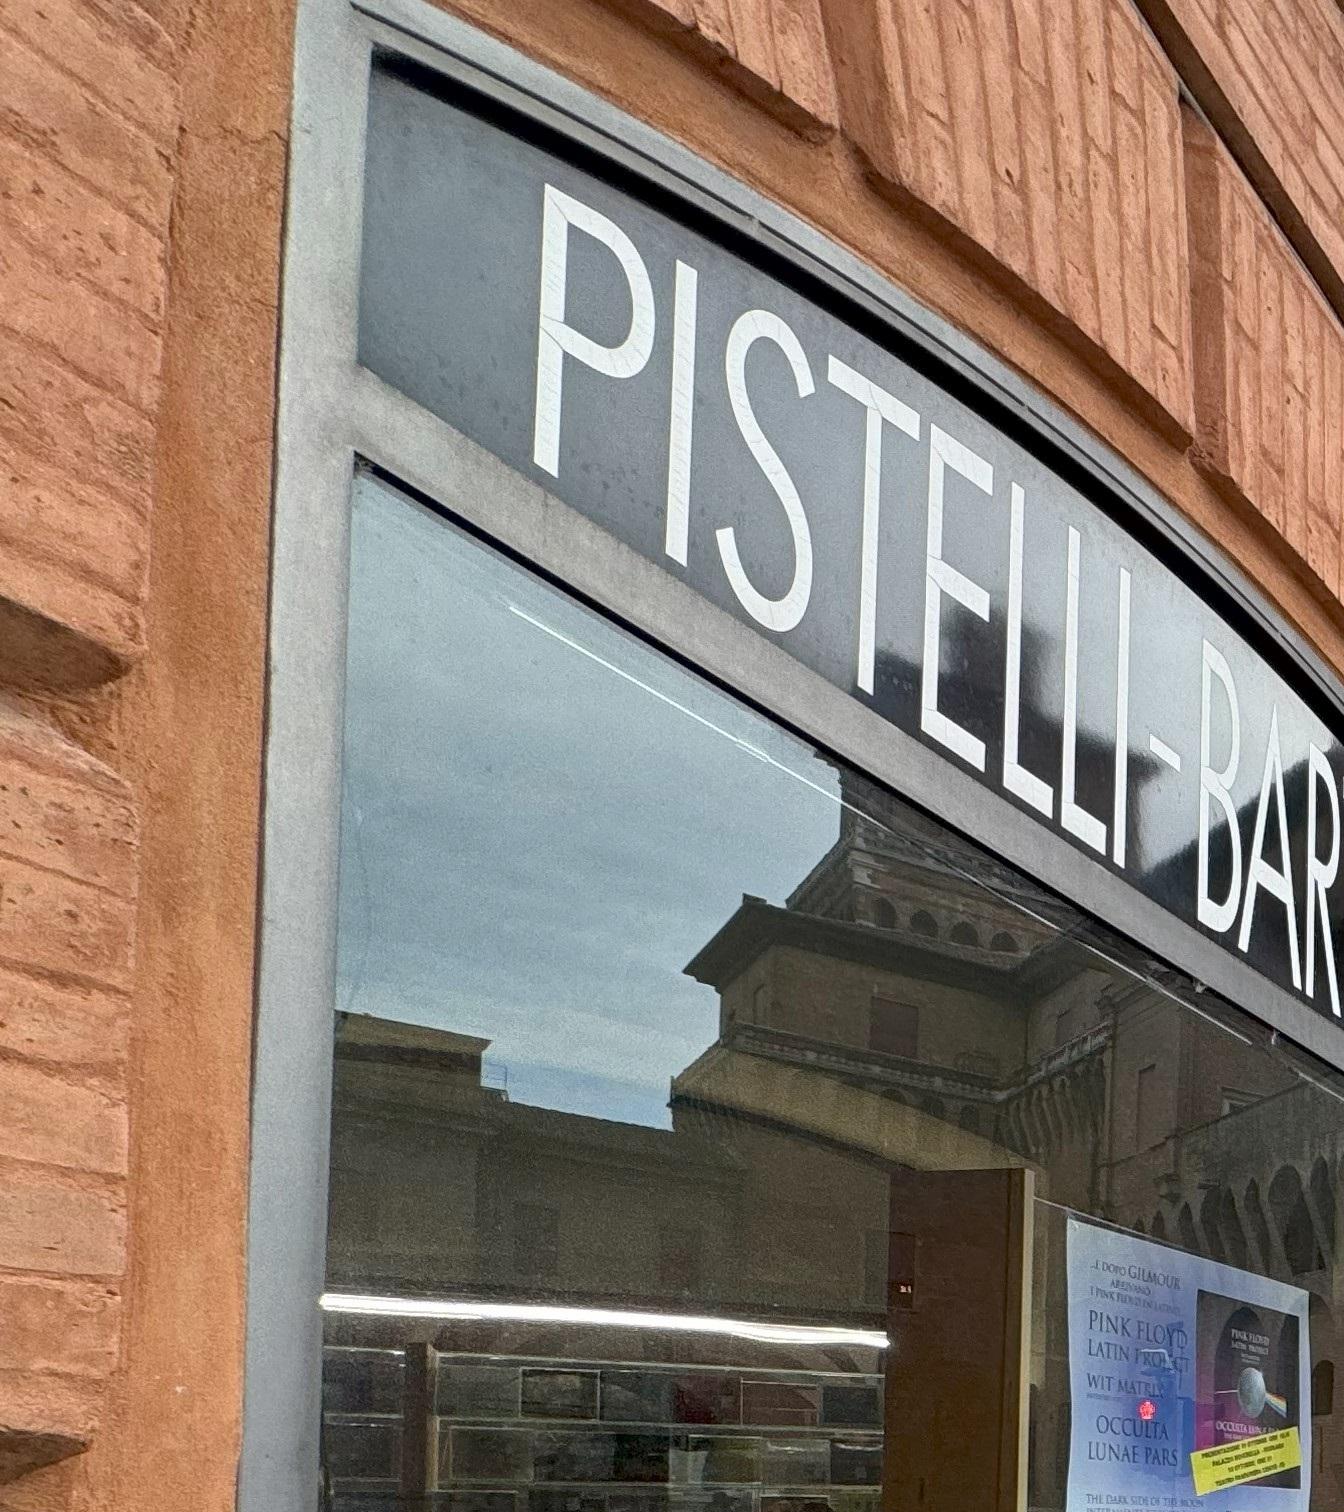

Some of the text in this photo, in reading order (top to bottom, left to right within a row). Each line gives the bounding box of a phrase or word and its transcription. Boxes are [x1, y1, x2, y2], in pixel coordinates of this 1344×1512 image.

[1089, 1310, 1188, 1350] PINK FLOYD
[1088, 1339, 1130, 1361] LATIN
[1096, 1415, 1169, 1440] OCCULTA
[1088, 1441, 1178, 1467] LUNAE PARS
